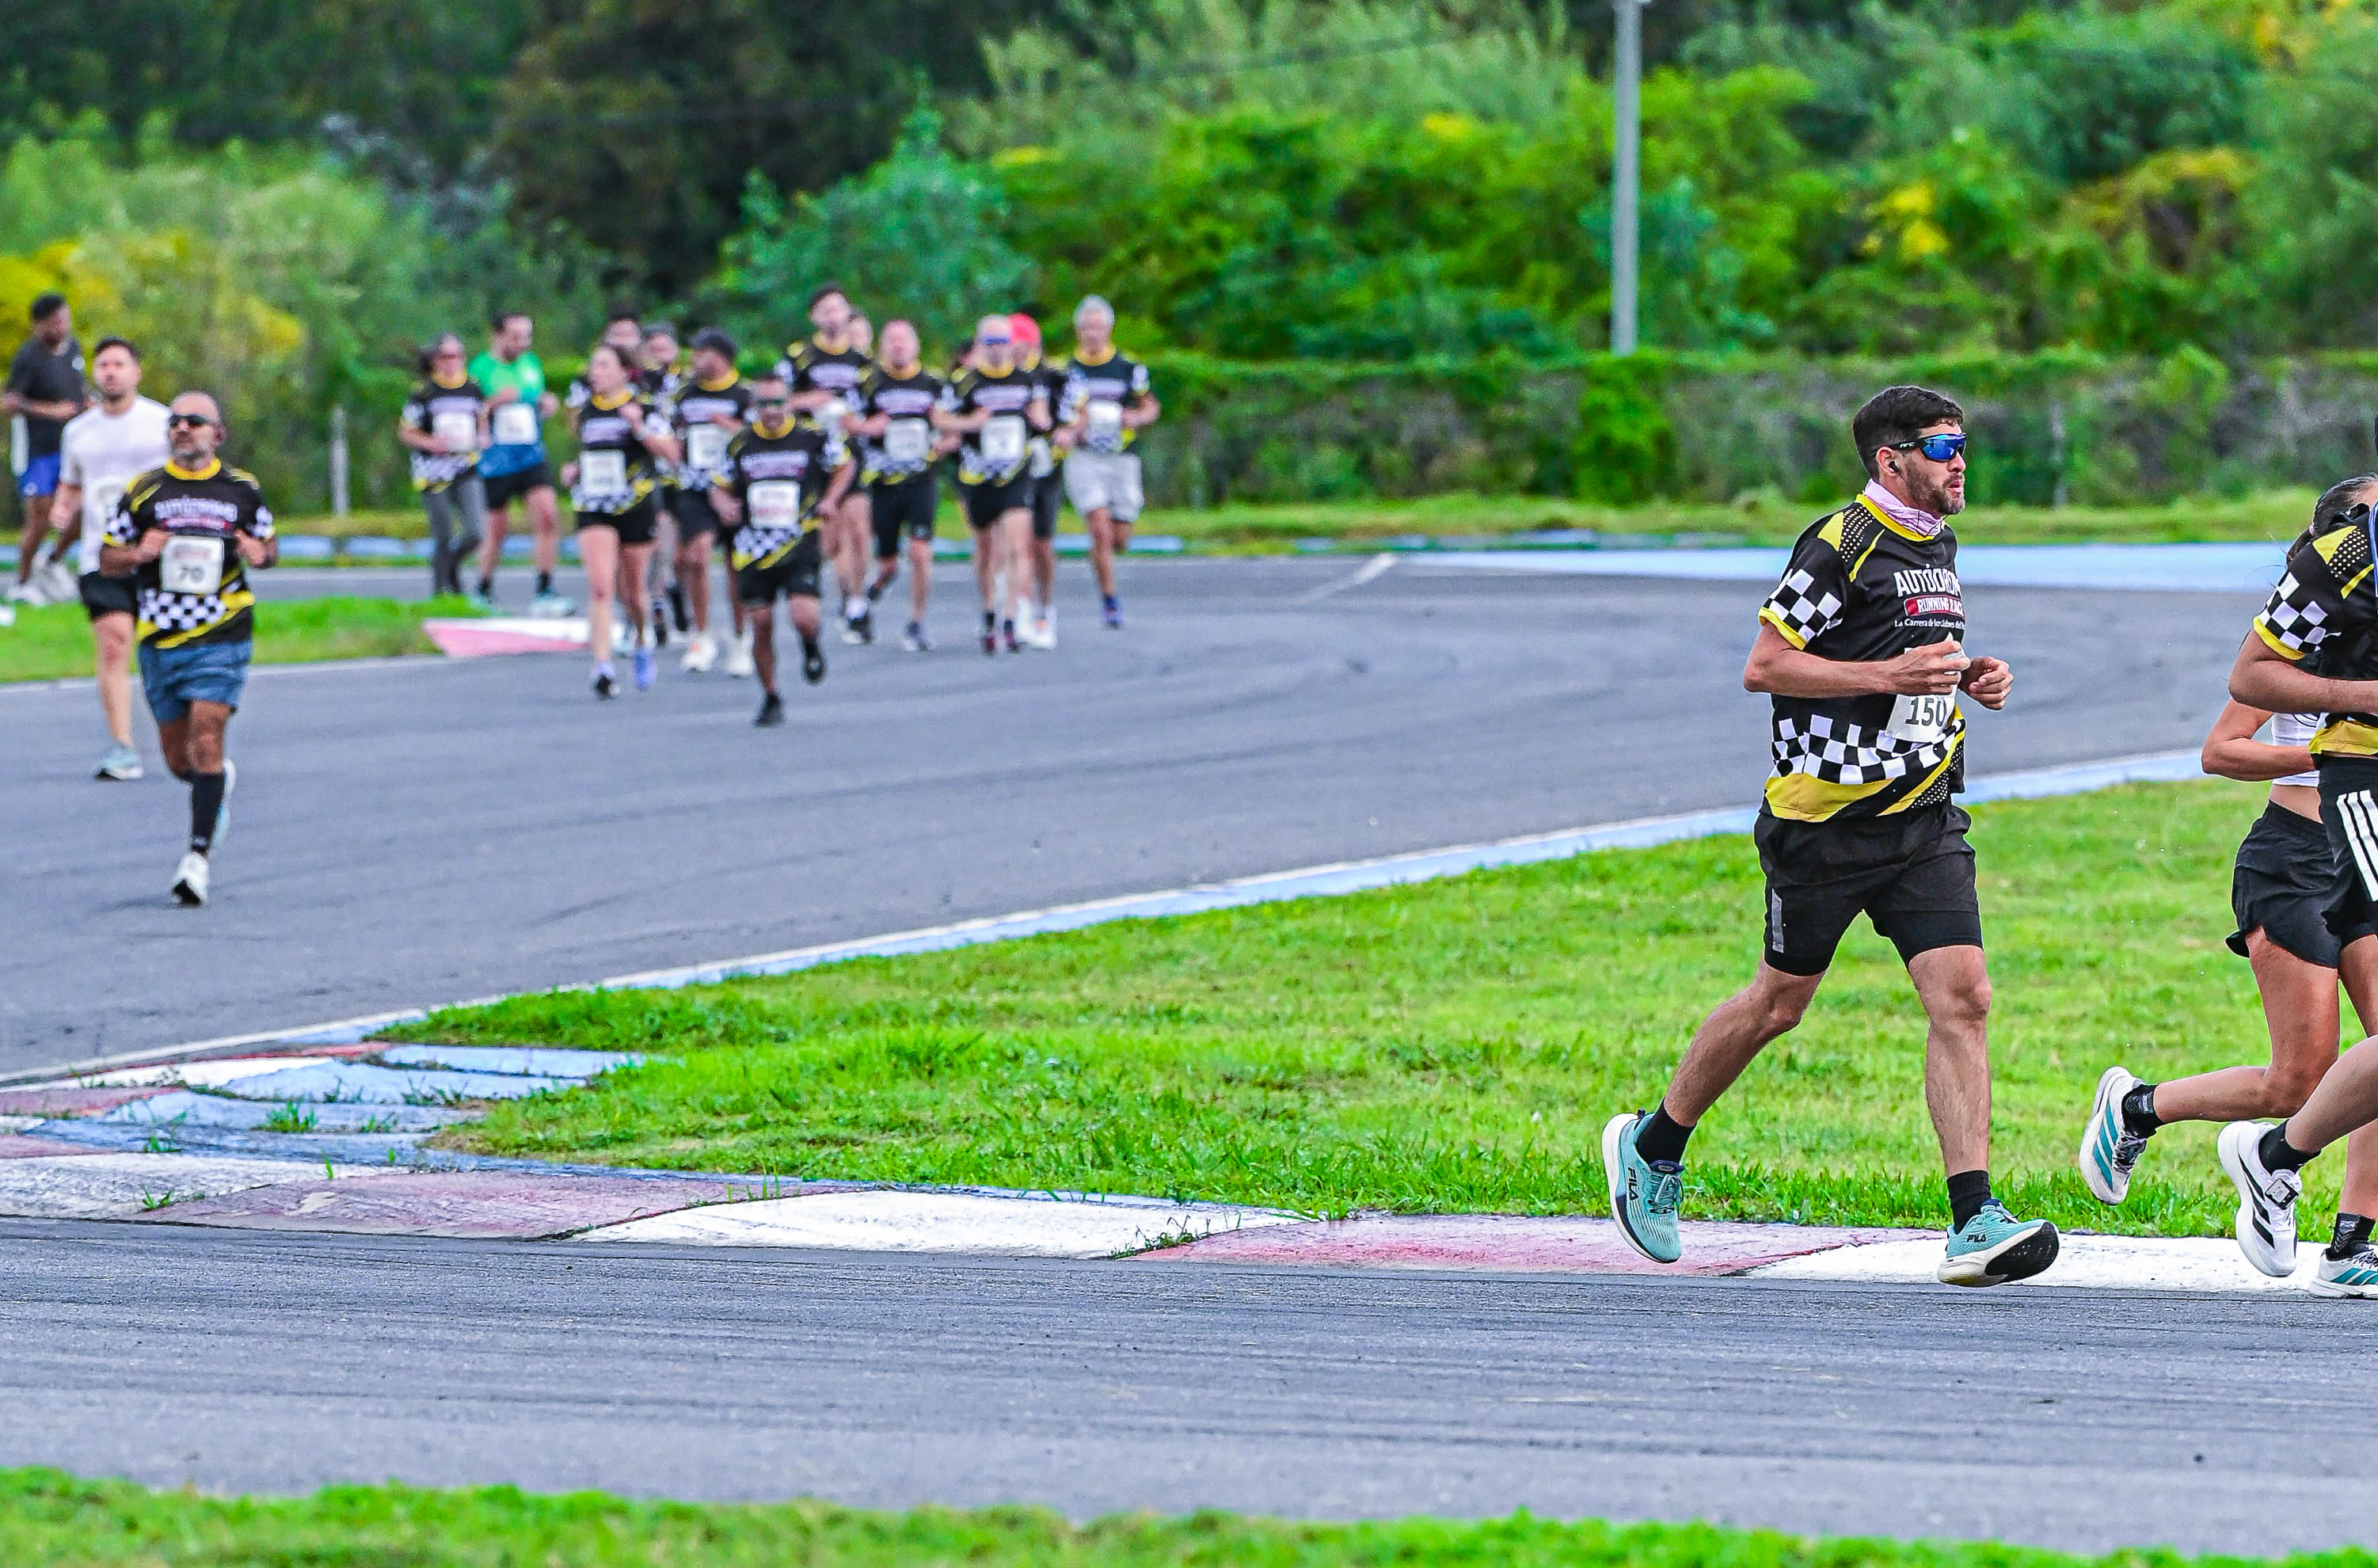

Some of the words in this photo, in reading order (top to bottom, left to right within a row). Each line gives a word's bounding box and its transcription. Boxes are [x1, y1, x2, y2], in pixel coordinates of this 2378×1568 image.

[178, 565, 205, 584] 70
[1916, 597, 1949, 614] RUNNING
[1904, 618, 1927, 627] Carrera
[1905, 697, 1946, 727] 150
[1627, 1166, 1638, 1201] FILA
[1966, 1233, 1987, 1243] FILA
